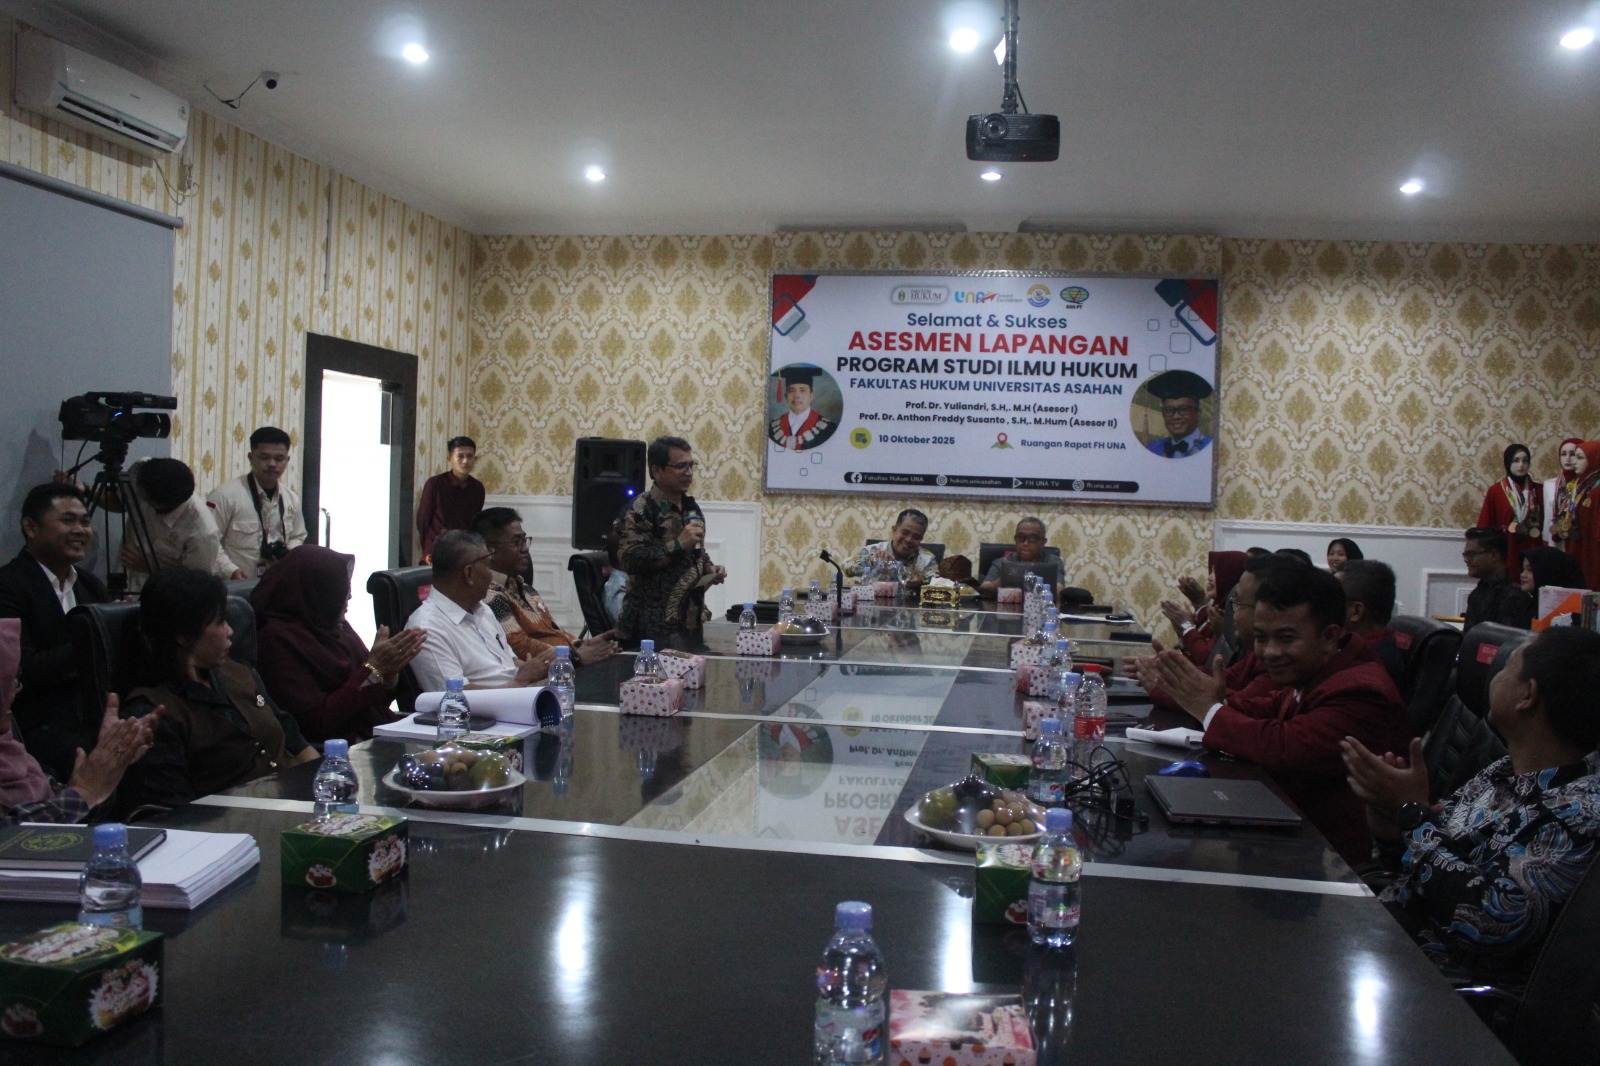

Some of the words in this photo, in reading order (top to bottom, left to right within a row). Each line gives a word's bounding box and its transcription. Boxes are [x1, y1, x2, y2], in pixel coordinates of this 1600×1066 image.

[910, 292, 942, 300] HUKUM
[907, 313, 982, 327] Selamat
[987, 315, 999, 327] &
[1005, 314, 1067, 329] Sukses
[848, 331, 972, 352] ASESMEN
[979, 333, 1128, 356] LAPANGAN
[837, 356, 938, 373] PROGRAM
[943, 358, 1002, 375] STUDI
[1007, 360, 1056, 376] ILMU
[1061, 362, 1137, 379] HUKUM
[850, 378, 917, 390] FAKULTAS
[920, 379, 970, 391] HUKUM
[973, 381, 1061, 393] UNIVERSITAS
[1064, 383, 1123, 395] ASAHAN
[905, 401, 927, 409] Prof.
[928, 402, 942, 410] Dr.
[944, 402, 989, 412] Yuliandri,
[1013, 404, 1031, 412] M.H
[1033, 403, 1070, 414] (Asesor
[1071, 404, 1078, 415] I)
[859, 412, 881, 421] Prof.
[882, 413, 895, 421] Dr.
[897, 414, 931, 422] Anthon
[932, 414, 965, 425] Freddy
[967, 415, 1006, 424] Susanto
[1033, 417, 1068, 426] M.Hum
[1069, 417, 1106, 428] (Asesor
[1107, 418, 1118, 429] II)
[879, 435, 889, 443] 10
[890, 435, 930, 444] Oktober
[932, 436, 955, 445] 2025
[1021, 439, 1063, 450] Ruangan
[1064, 441, 1092, 450] Rapat
[1106, 442, 1127, 450] UNA
